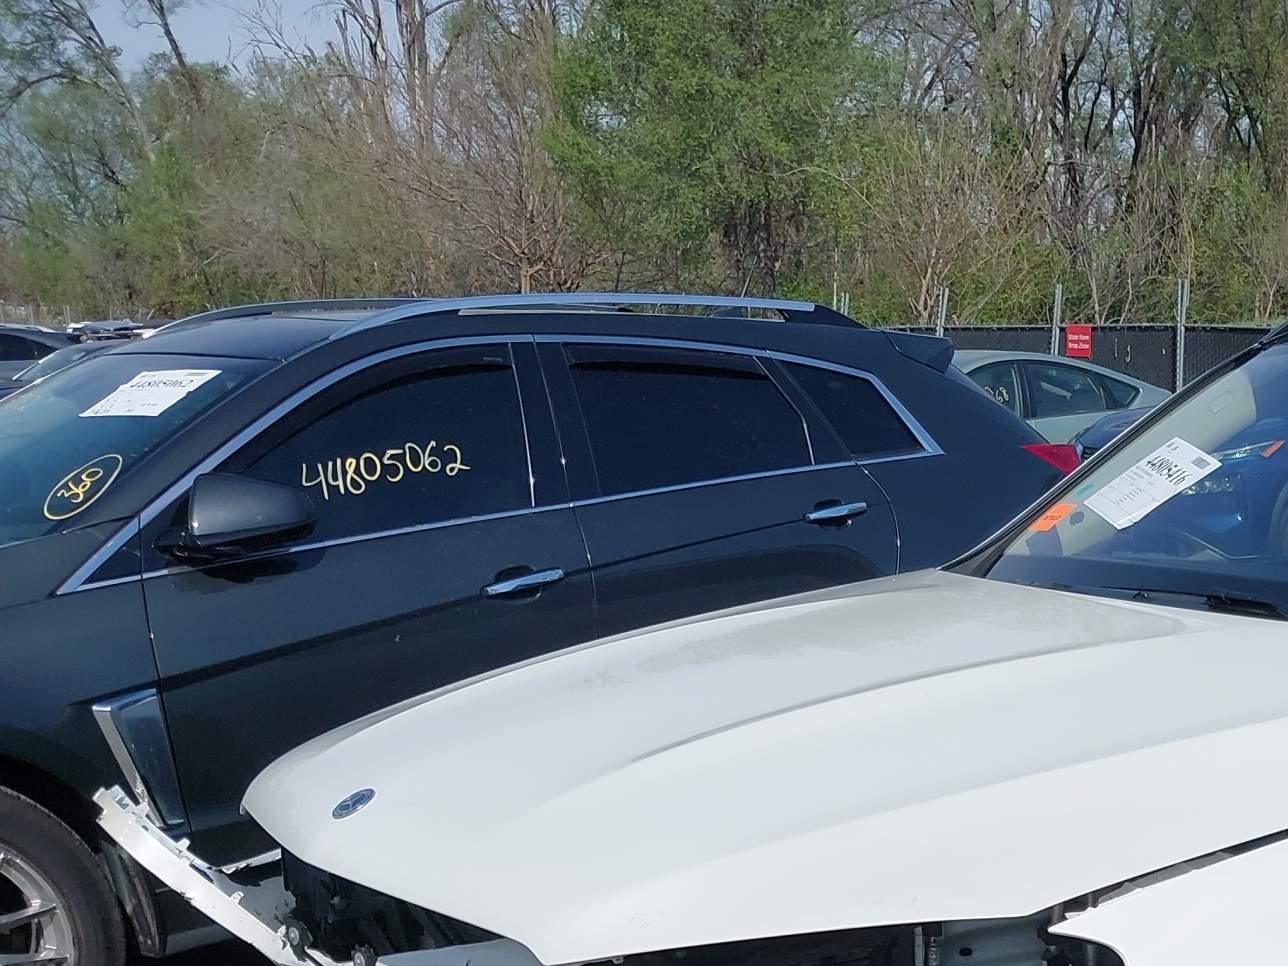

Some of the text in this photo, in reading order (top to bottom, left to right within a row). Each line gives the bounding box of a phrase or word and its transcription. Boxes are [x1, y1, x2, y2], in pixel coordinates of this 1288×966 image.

[56, 468, 104, 503] 360
[301, 440, 472, 501] 44805062
[1144, 455, 1193, 487] 44805416
